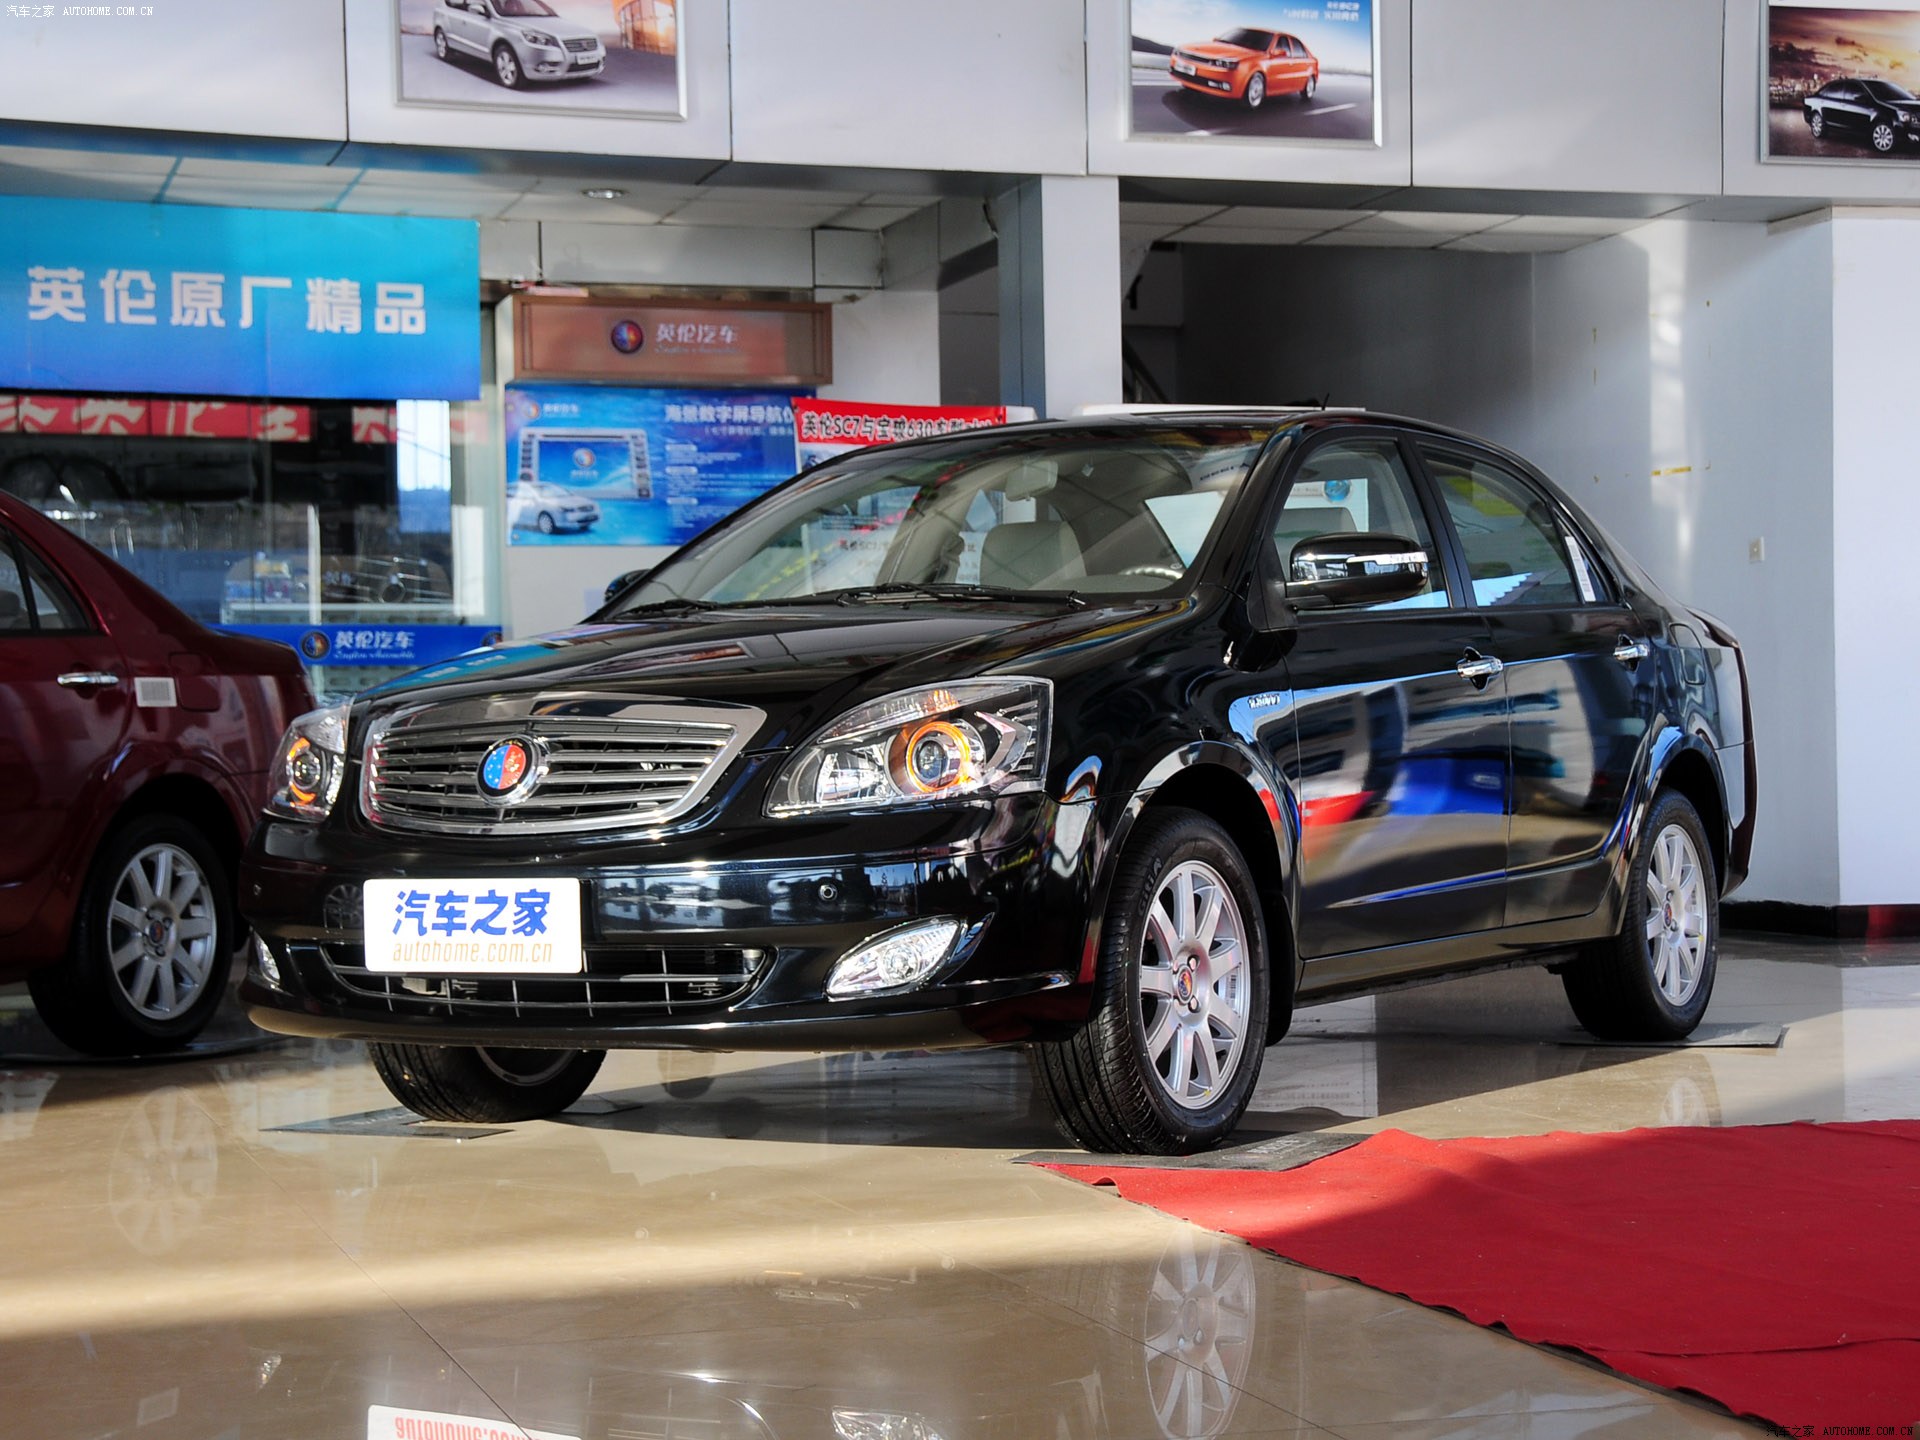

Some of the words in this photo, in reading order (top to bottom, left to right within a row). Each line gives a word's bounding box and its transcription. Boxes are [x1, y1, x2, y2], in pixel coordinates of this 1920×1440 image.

[27, 265, 427, 335] 英伦原厂精品
[655, 322, 738, 344] 英伦汽车
[335, 630, 415, 649] 英伦汽车
[392, 888, 551, 937] 汽车之家
[392, 940, 552, 963] autohome.com.cn
